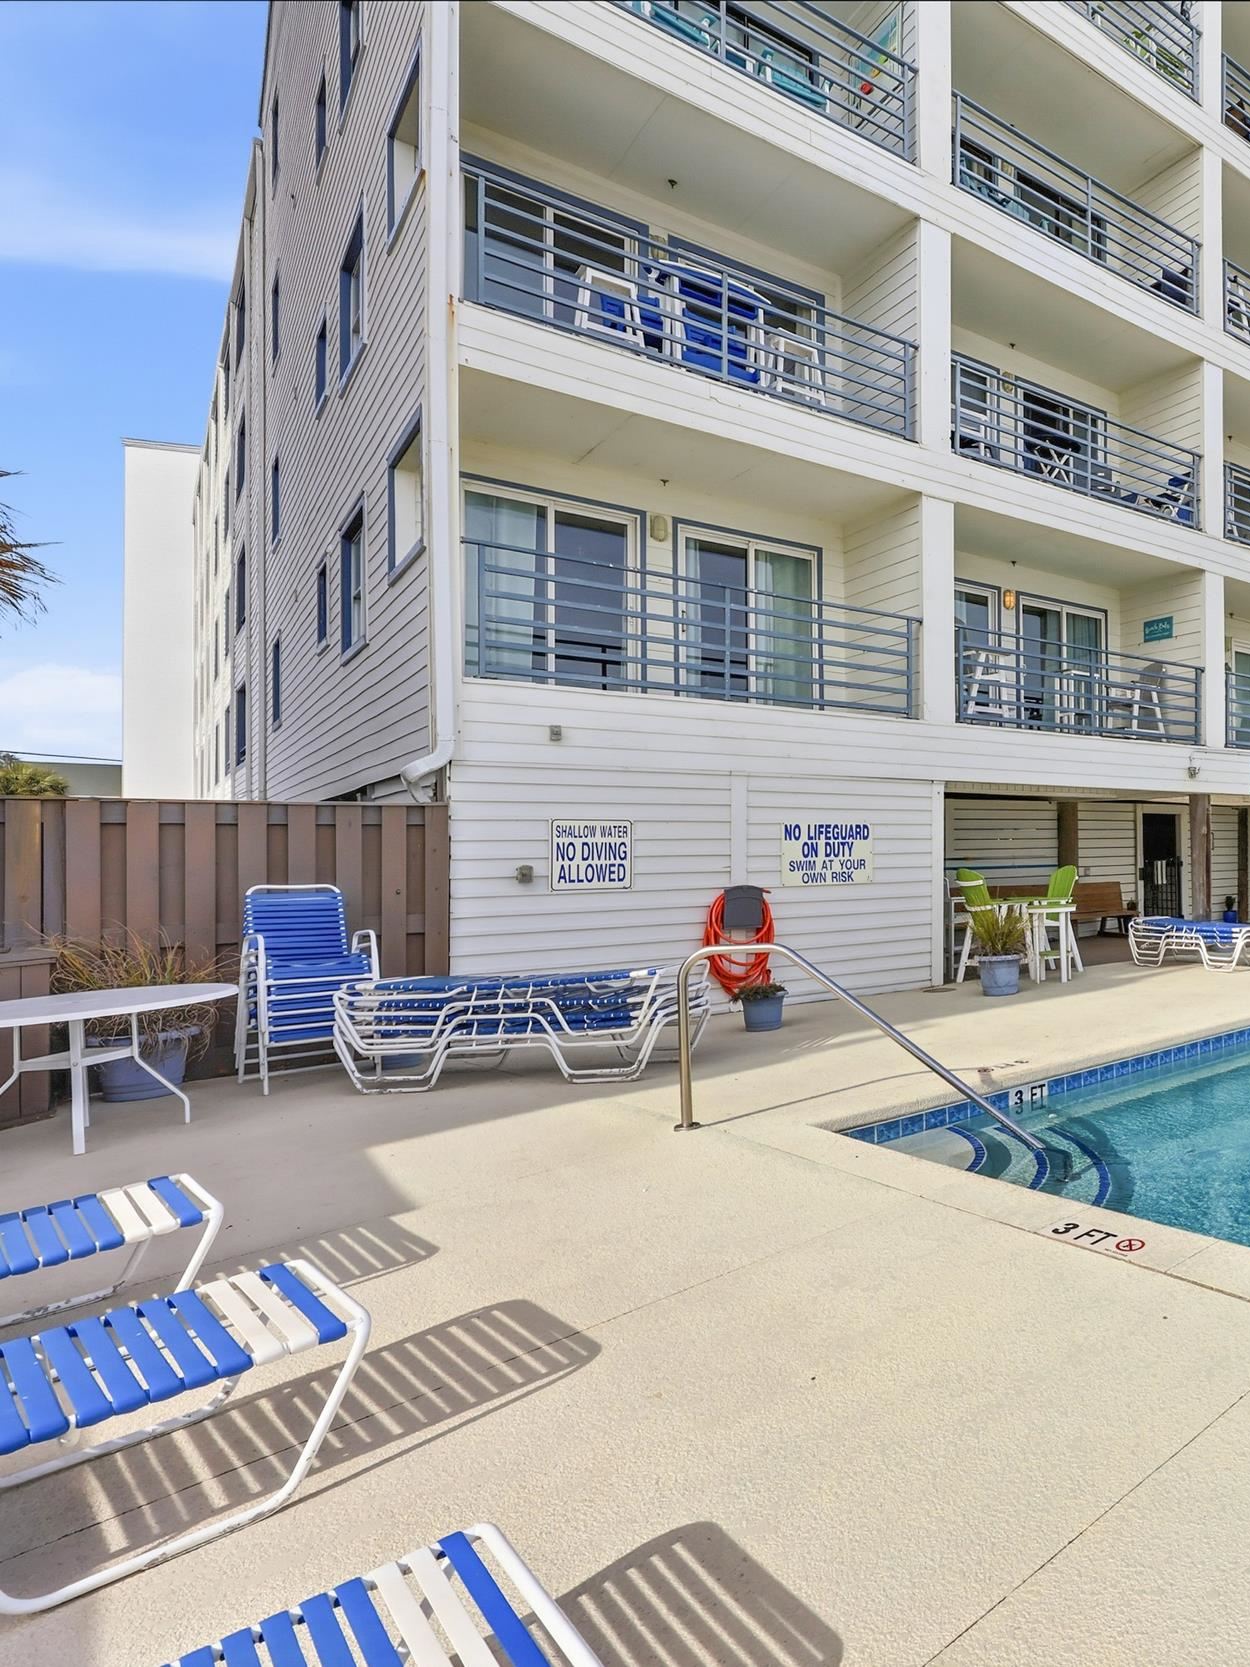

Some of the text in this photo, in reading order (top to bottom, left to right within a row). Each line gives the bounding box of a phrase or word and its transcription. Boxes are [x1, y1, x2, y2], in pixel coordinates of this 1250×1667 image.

[555, 825, 628, 838] SHALLOW WATER
[784, 824, 870, 841] NO LIFEGUARD
[556, 841, 627, 862] NO DIVING
[802, 841, 854, 858] ON DUTY
[557, 863, 626, 884] ALLOWED
[788, 859, 866, 872] SWIM AT YOUR
[802, 871, 854, 884] OWN RISK
[1014, 1083, 1046, 1105] 3 FT
[1051, 1222, 1118, 1245] 3 FT
